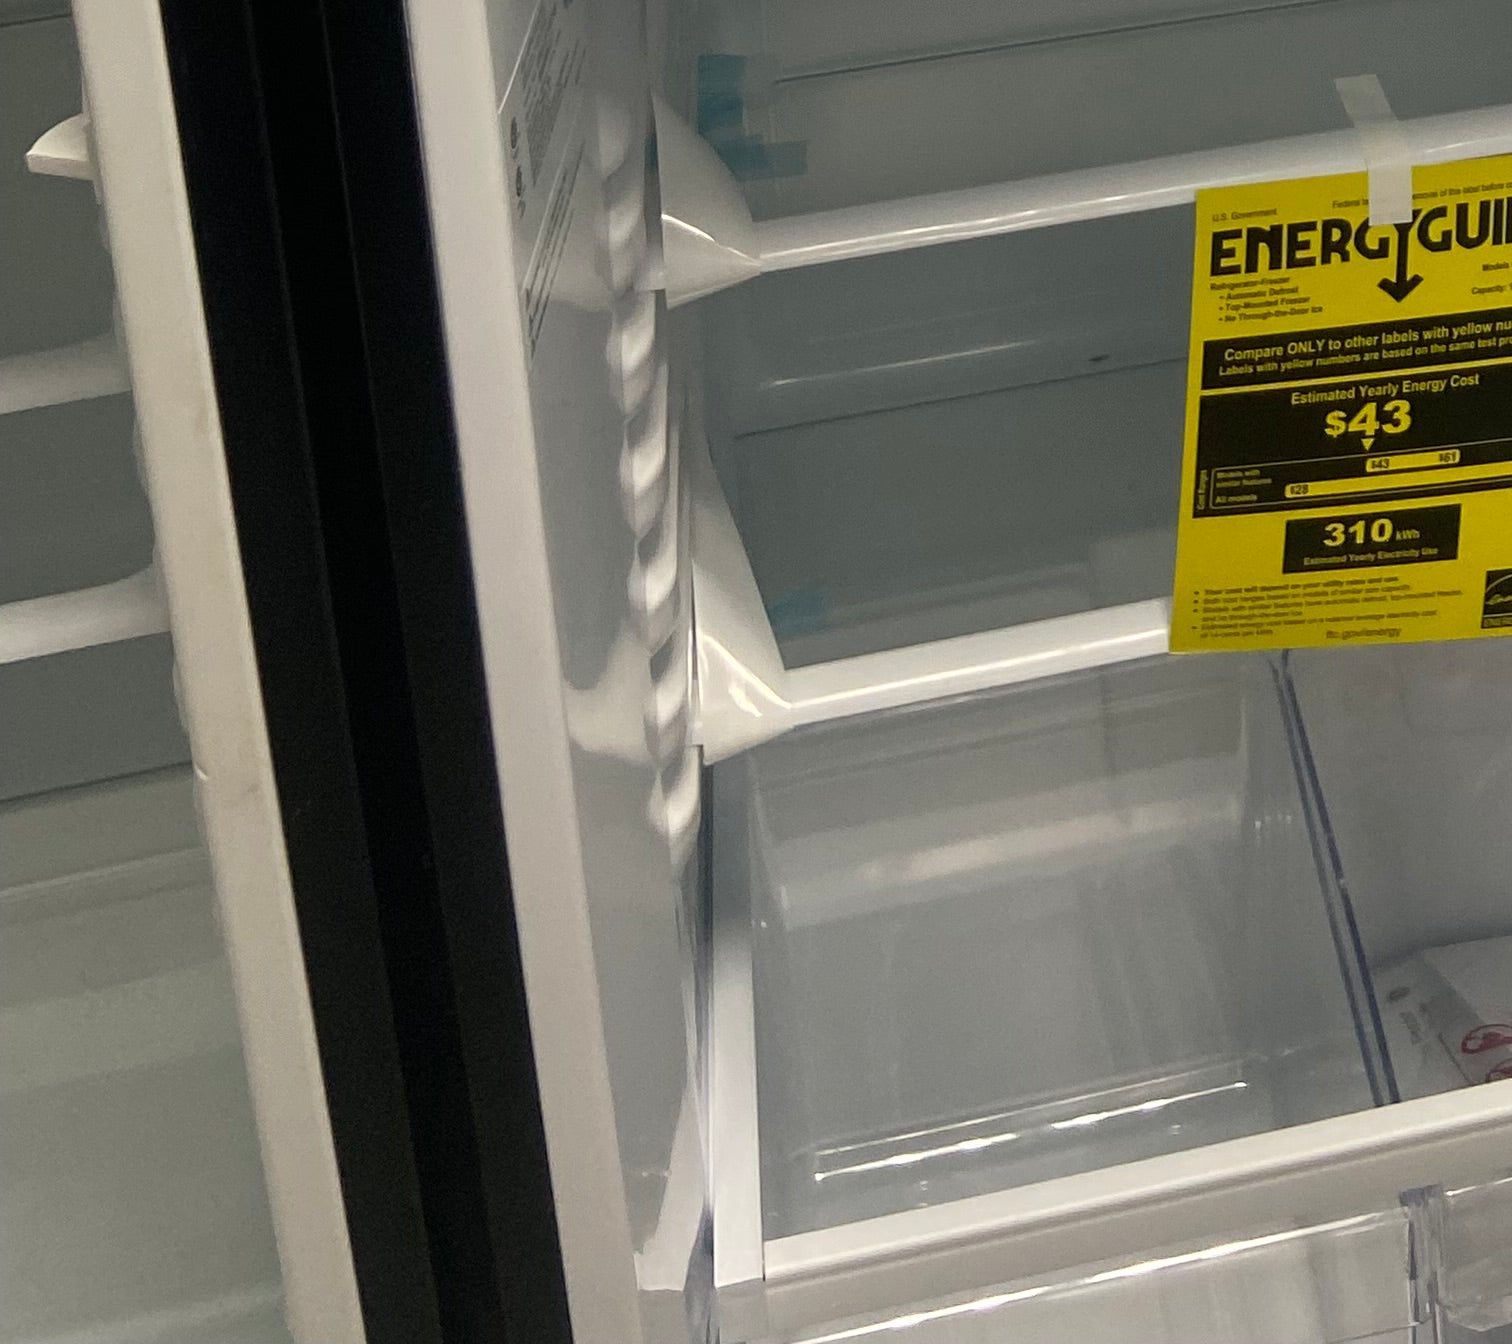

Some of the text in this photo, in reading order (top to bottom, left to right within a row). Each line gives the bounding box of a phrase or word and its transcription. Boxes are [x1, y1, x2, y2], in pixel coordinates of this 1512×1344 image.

[1223, 345, 1283, 361] Compare
[1286, 338, 1325, 354] ONLY
[1327, 339, 1341, 350] to
[1344, 334, 1378, 348] other
[1381, 328, 1419, 344] labels
[1422, 325, 1449, 340] with
[1451, 321, 1493, 339] yellow
[1290, 373, 1479, 405] Estimated Yearly Energy Cost
[1323, 399, 1411, 438] $43
[1322, 517, 1393, 546] 310
